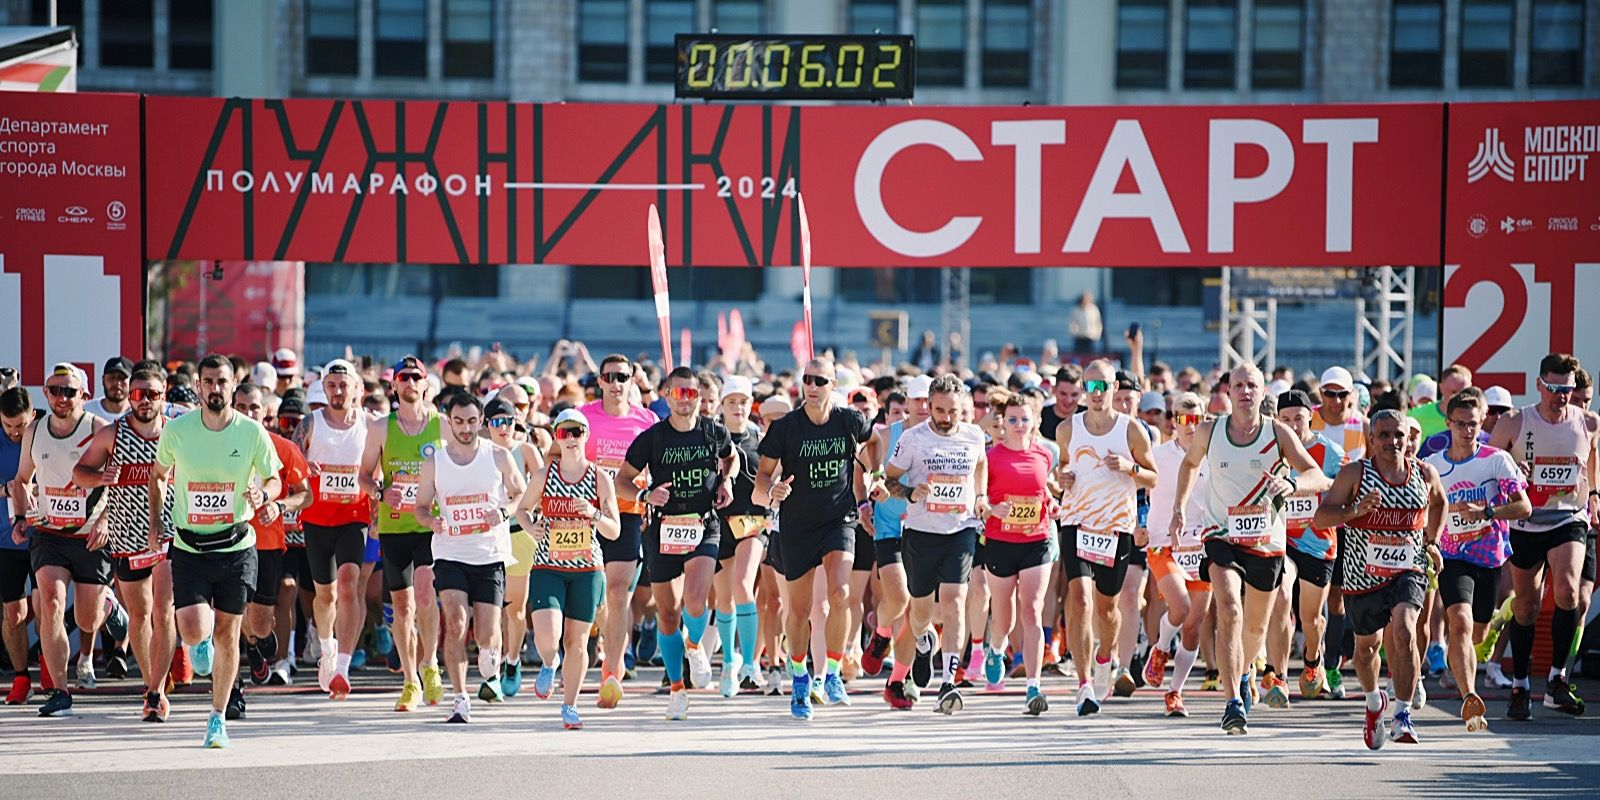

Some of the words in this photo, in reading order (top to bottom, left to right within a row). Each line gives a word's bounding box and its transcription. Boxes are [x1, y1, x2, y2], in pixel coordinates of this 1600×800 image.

[0, 117, 108, 136] Департамент
[1525, 125, 1600, 153] МОСКО
[0, 141, 56, 157] спорта
[0, 162, 56, 177] города
[62, 160, 126, 177] Москвы
[1523, 154, 1588, 182] СПОРТ
[166, 97, 801, 263] ЛУЖНИКИ
[206, 170, 492, 196] ПОЛУМАРАФОН
[716, 176, 798, 198] 2024
[854, 118, 1379, 257] СТАРТ
[16, 214, 46, 222] FITNESS
[1540, 467, 1572, 480] 6597
[326, 475, 355, 488] 2104
[933, 485, 963, 498] 3467
[50, 498, 80, 512] 7663
[194, 494, 227, 508] 3326
[453, 508, 484, 521] 8315
[1009, 506, 1036, 518] 3226
[1235, 516, 1267, 531] 3075
[556, 531, 584, 544] 2431
[667, 527, 697, 540] 7878
[1082, 534, 1112, 550] 5197
[1373, 547, 1407, 562] 7646
